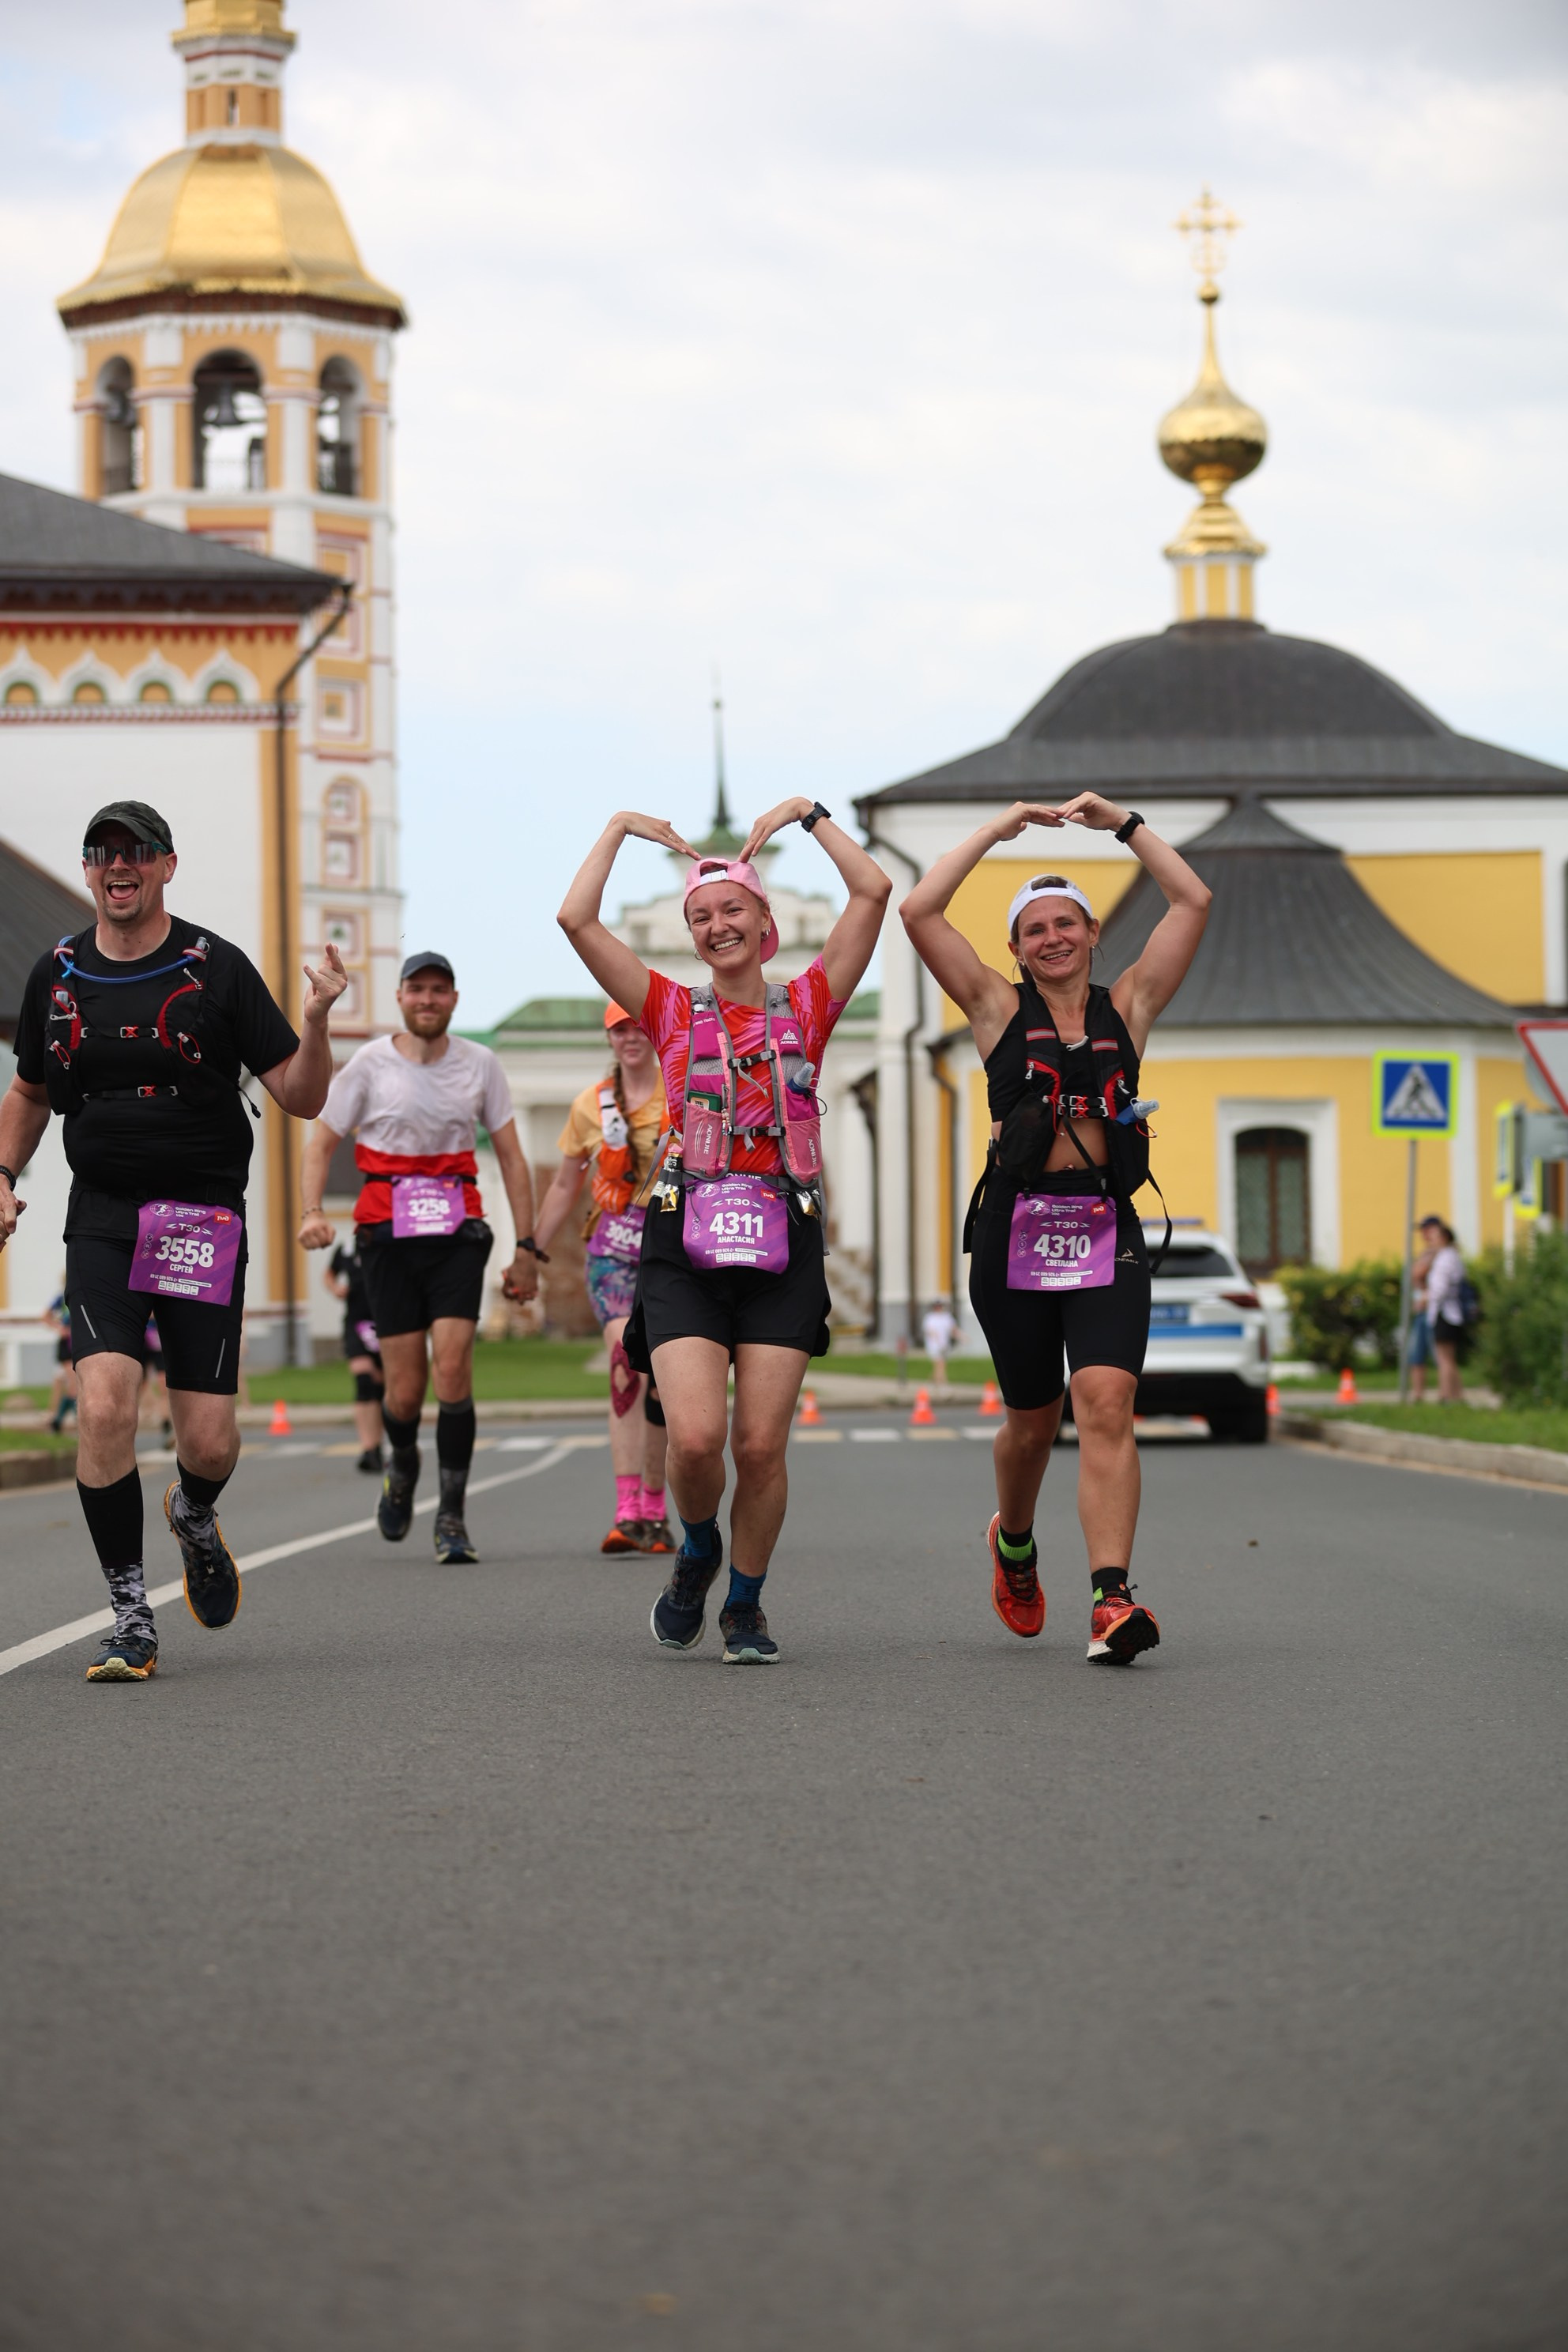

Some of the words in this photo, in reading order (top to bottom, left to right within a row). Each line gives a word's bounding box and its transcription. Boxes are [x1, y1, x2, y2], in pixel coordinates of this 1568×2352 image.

[408, 1197, 450, 1217] 3258
[179, 1223, 201, 1233] T30
[710, 1212, 763, 1238] 4311
[155, 1236, 215, 1268] 3558
[1033, 1234, 1091, 1259] 4310
[169, 1264, 194, 1274] СЕРГЕЙ
[1046, 1258, 1078, 1268] СВЕТЛАНА
